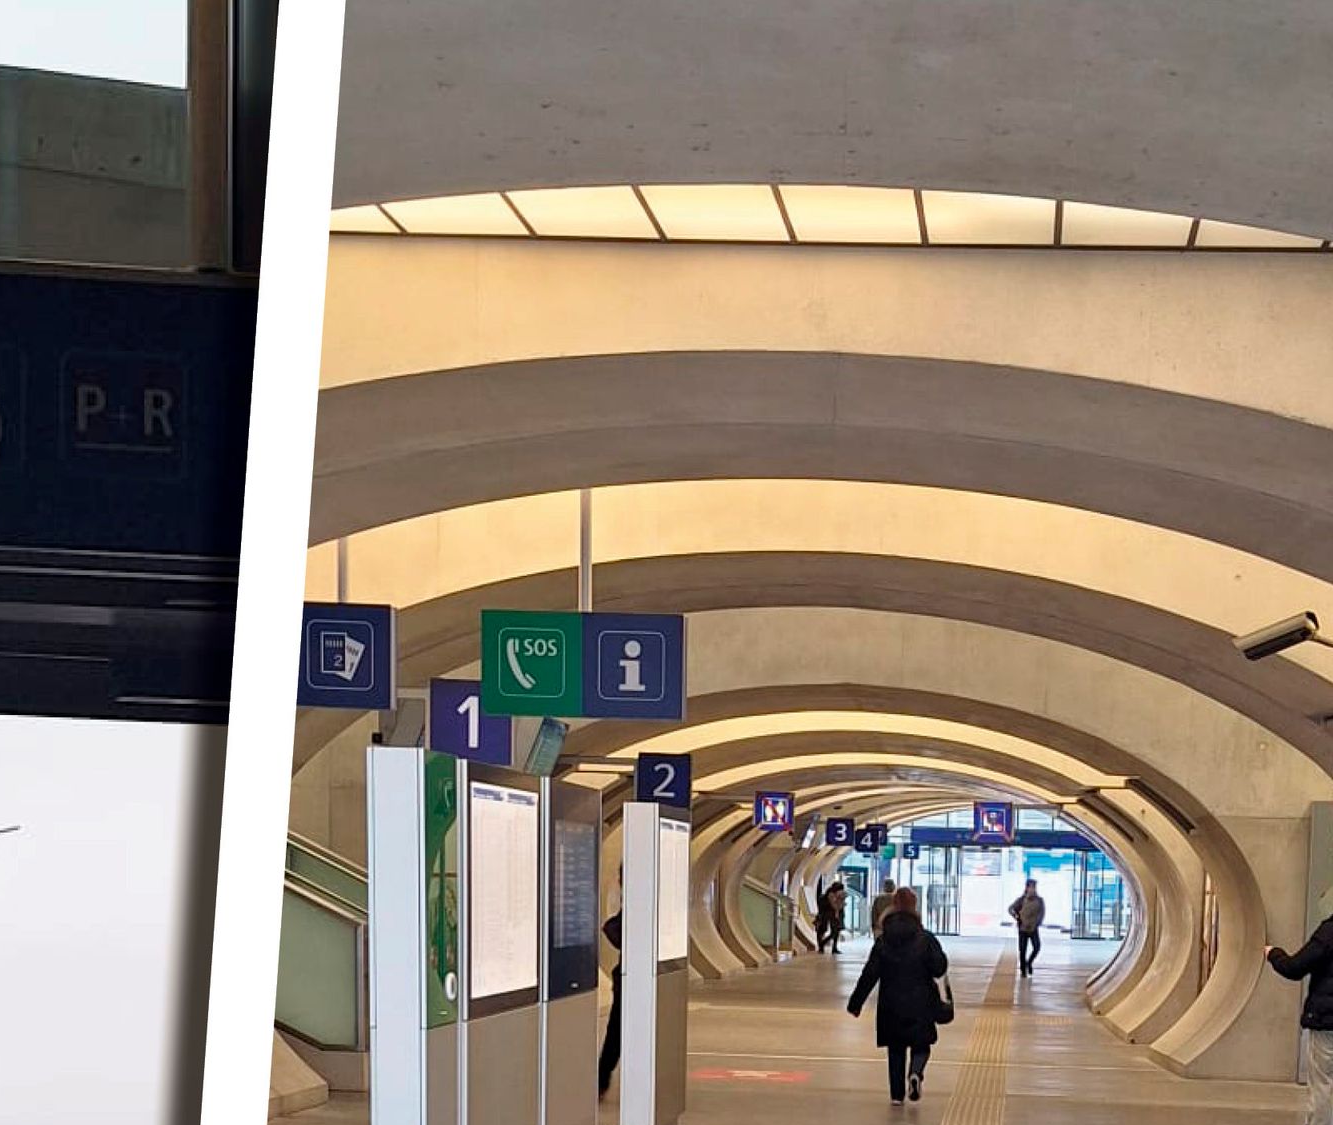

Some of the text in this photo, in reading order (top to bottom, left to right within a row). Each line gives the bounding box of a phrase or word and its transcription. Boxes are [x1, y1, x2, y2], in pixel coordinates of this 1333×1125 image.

[524, 638, 557, 657] SOS
[457, 695, 480, 748] 1
[653, 763, 676, 798] 2
[834, 823, 847, 841] 3
[859, 832, 873, 849] 4
[906, 845, 916, 857] 5
